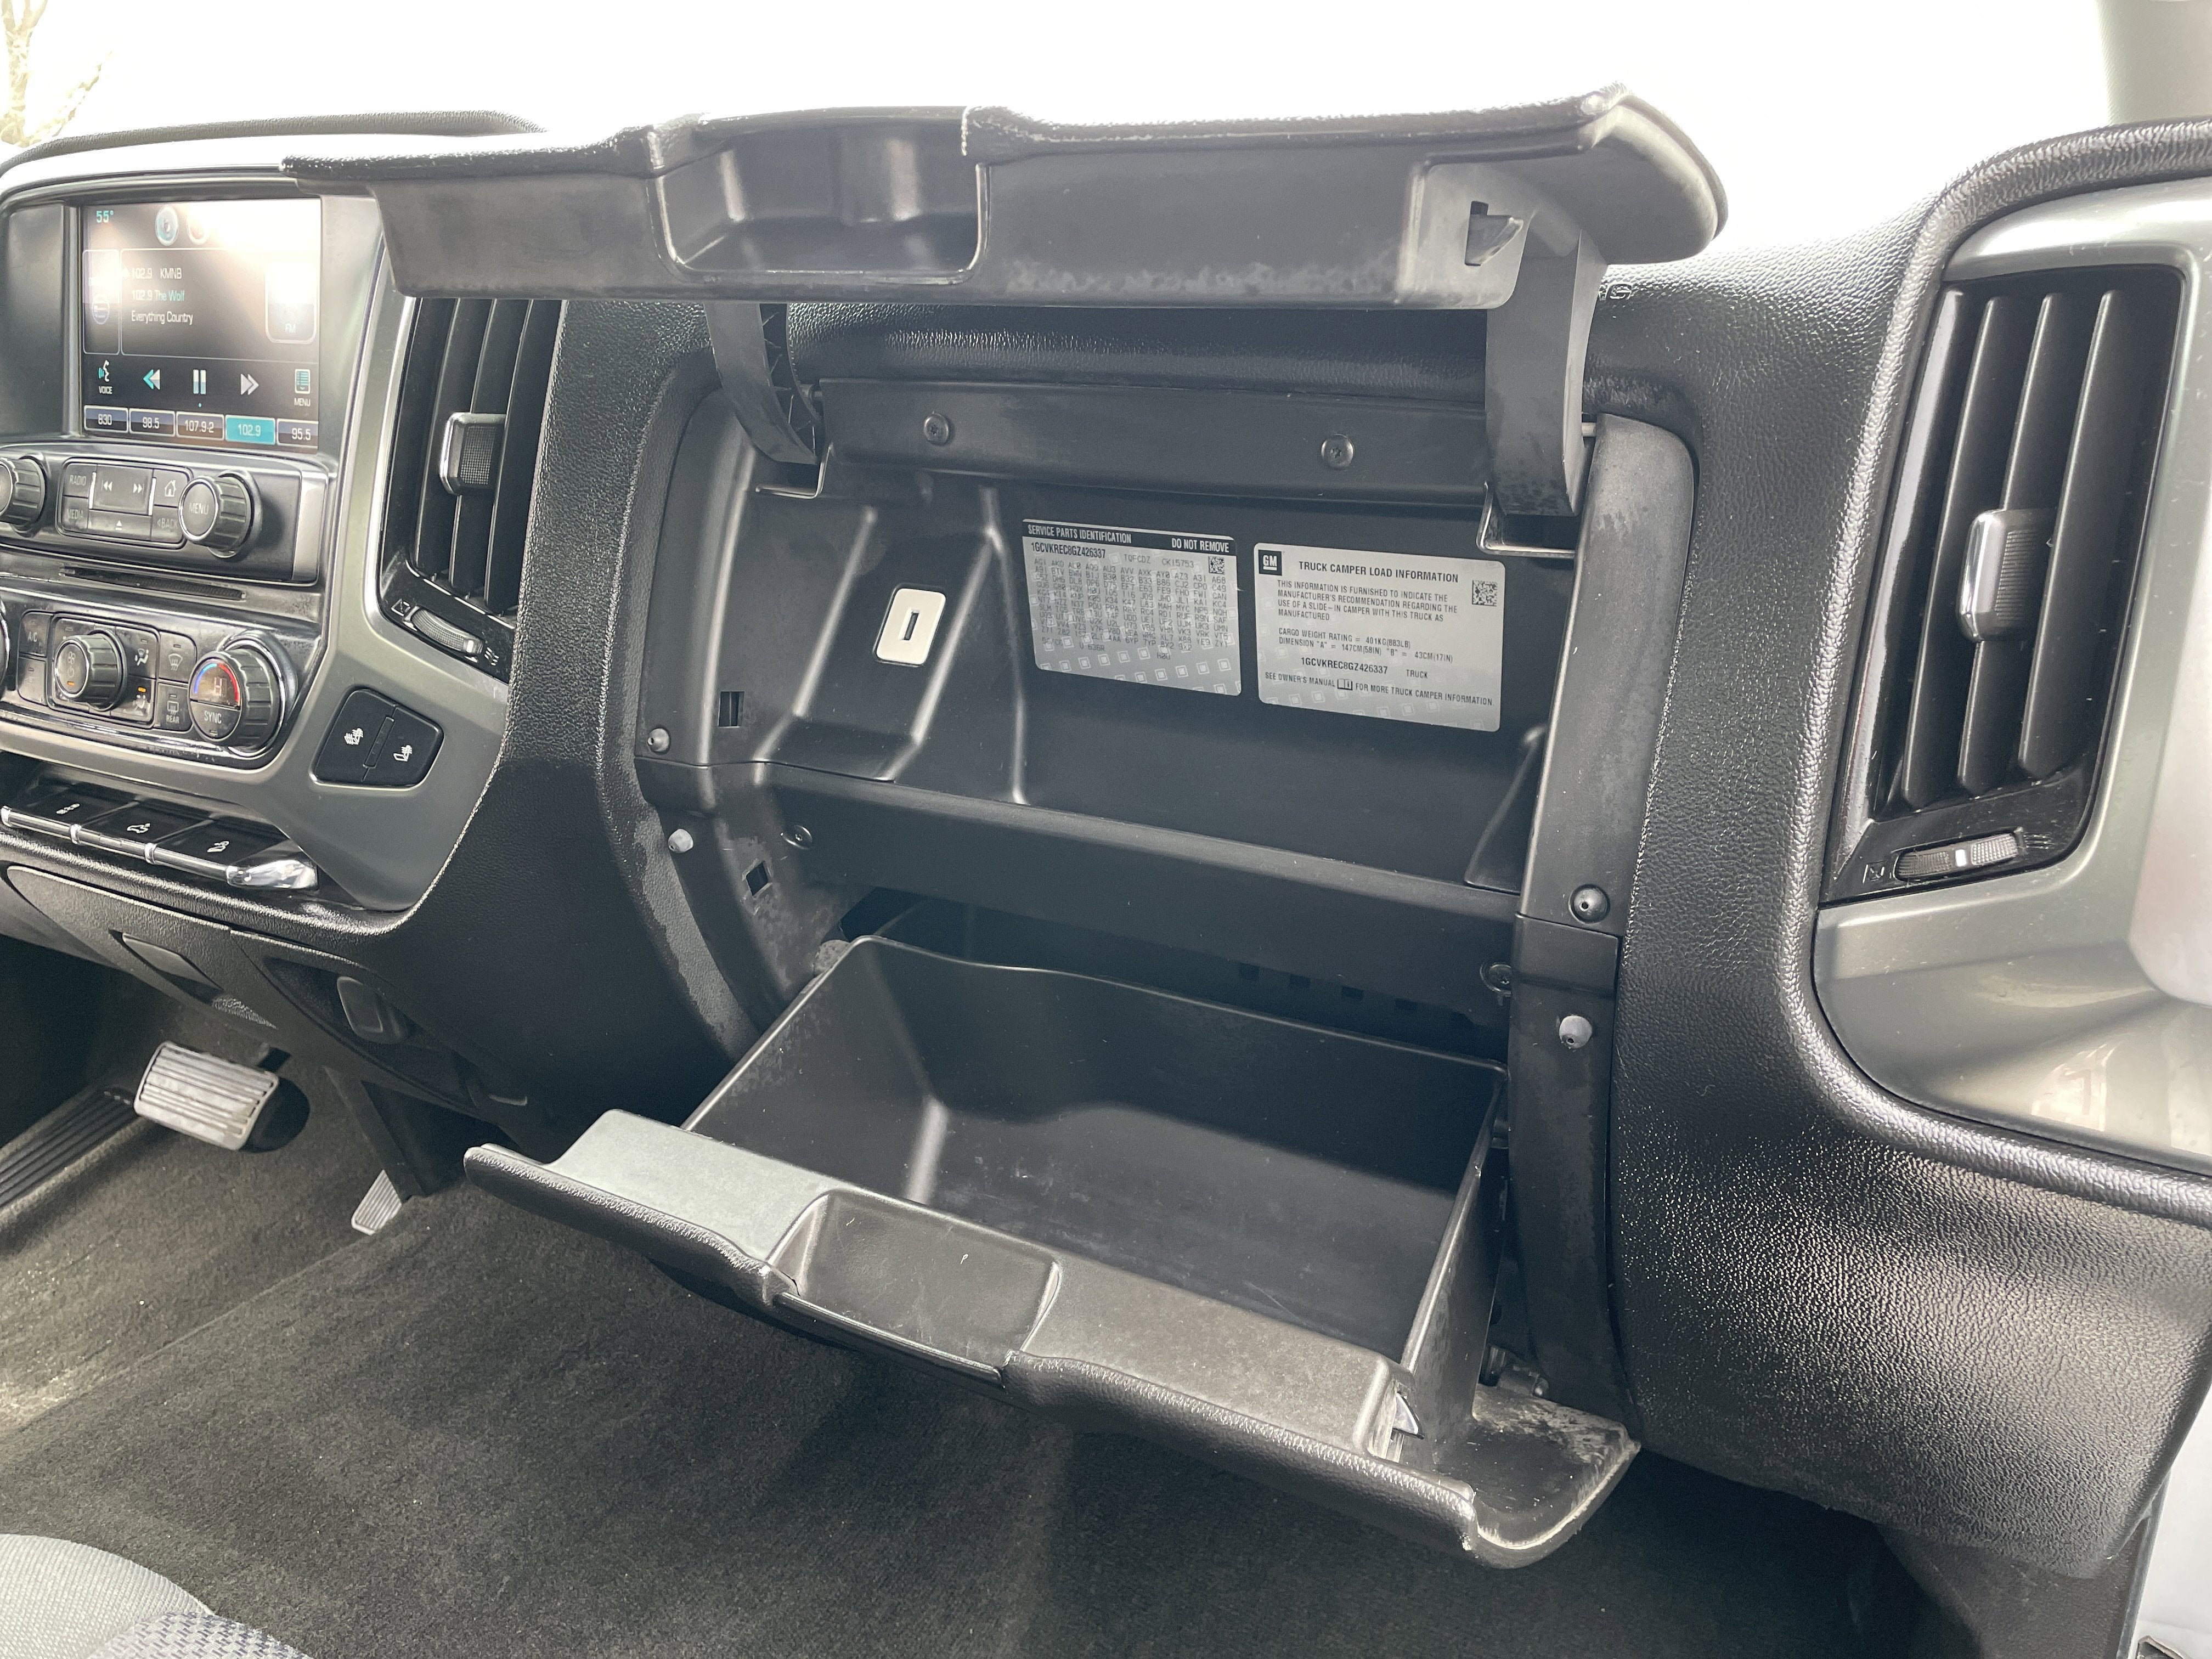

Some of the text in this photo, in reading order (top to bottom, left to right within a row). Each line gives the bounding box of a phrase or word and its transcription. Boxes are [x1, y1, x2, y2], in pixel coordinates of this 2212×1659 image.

[132, 268, 182, 279] 102.9 KMNB
[132, 290, 185, 301] 102.9 The Wolf
[131, 310, 193, 325] Everything Country
[285, 323, 296, 333] FM
[98, 386, 113, 395] VOICE
[294, 398, 311, 407] MENU
[142, 417, 160, 430] 98.5
[185, 420, 214, 434] 107.9-2
[238, 424, 261, 437] 102.9
[291, 427, 311, 441] 95.5
[69, 475, 87, 486] RADIO
[67, 509, 83, 520] MEDIA
[189, 503, 208, 515] MENU
[161, 517, 178, 529] BACK
[1028, 524, 1131, 544] SERVICE PARTS IDENTIFICATION
[1031, 541, 1106, 558] 1GCVKREC8GZ426337
[1171, 538, 1229, 553] DO NOT REMOVE
[1262, 554, 1277, 567] GM
[1299, 561, 1458, 583] TRUCK CAMPER LOAD INFORMATION
[1121, 574, 1135, 583] B32
[1211, 576, 1226, 584] A68
[1157, 586, 1171, 595] FE9
[1277, 579, 1291, 588] THIS
[1294, 581, 1338, 592] INFORMATION
[1350, 586, 1387, 597] FURNISHED
[1401, 591, 1431, 601] INDICATE
[1435, 594, 1447, 602] THE
[1278, 589, 1457, 613] MANUFACTURER'S RECOMMENDATION REGARDING THE
[1176, 604, 1190, 612] MYC
[1278, 599, 1290, 607] USE
[1343, 605, 1369, 614] CAMPER
[1372, 608, 1389, 617] WITH
[1392, 610, 1407, 618] THIS
[1410, 612, 1432, 620] TRUCK
[1278, 608, 1329, 620] MANUFACTURED
[1213, 616, 1227, 624] SAF
[28, 632, 37, 642] A/C
[1177, 628, 1191, 636] VK3
[1279, 627, 1299, 636] CARGO
[1301, 630, 1325, 639] WEIGHT
[1329, 633, 1352, 642] RATING
[1125, 636, 1139, 645] 6YP
[1142, 639, 1156, 647] 7YP
[1279, 636, 1313, 647] DIMENSION
[1301, 657, 1427, 679] 1GCVKREC8GZ426337 TRUCK
[1265, 672, 1492, 706] SEE OWNER'S MANUAL FOR MORE TRUCK CAMPER INFORMATION
[166, 714, 179, 724] REAR
[204, 710, 222, 724] SYNC
